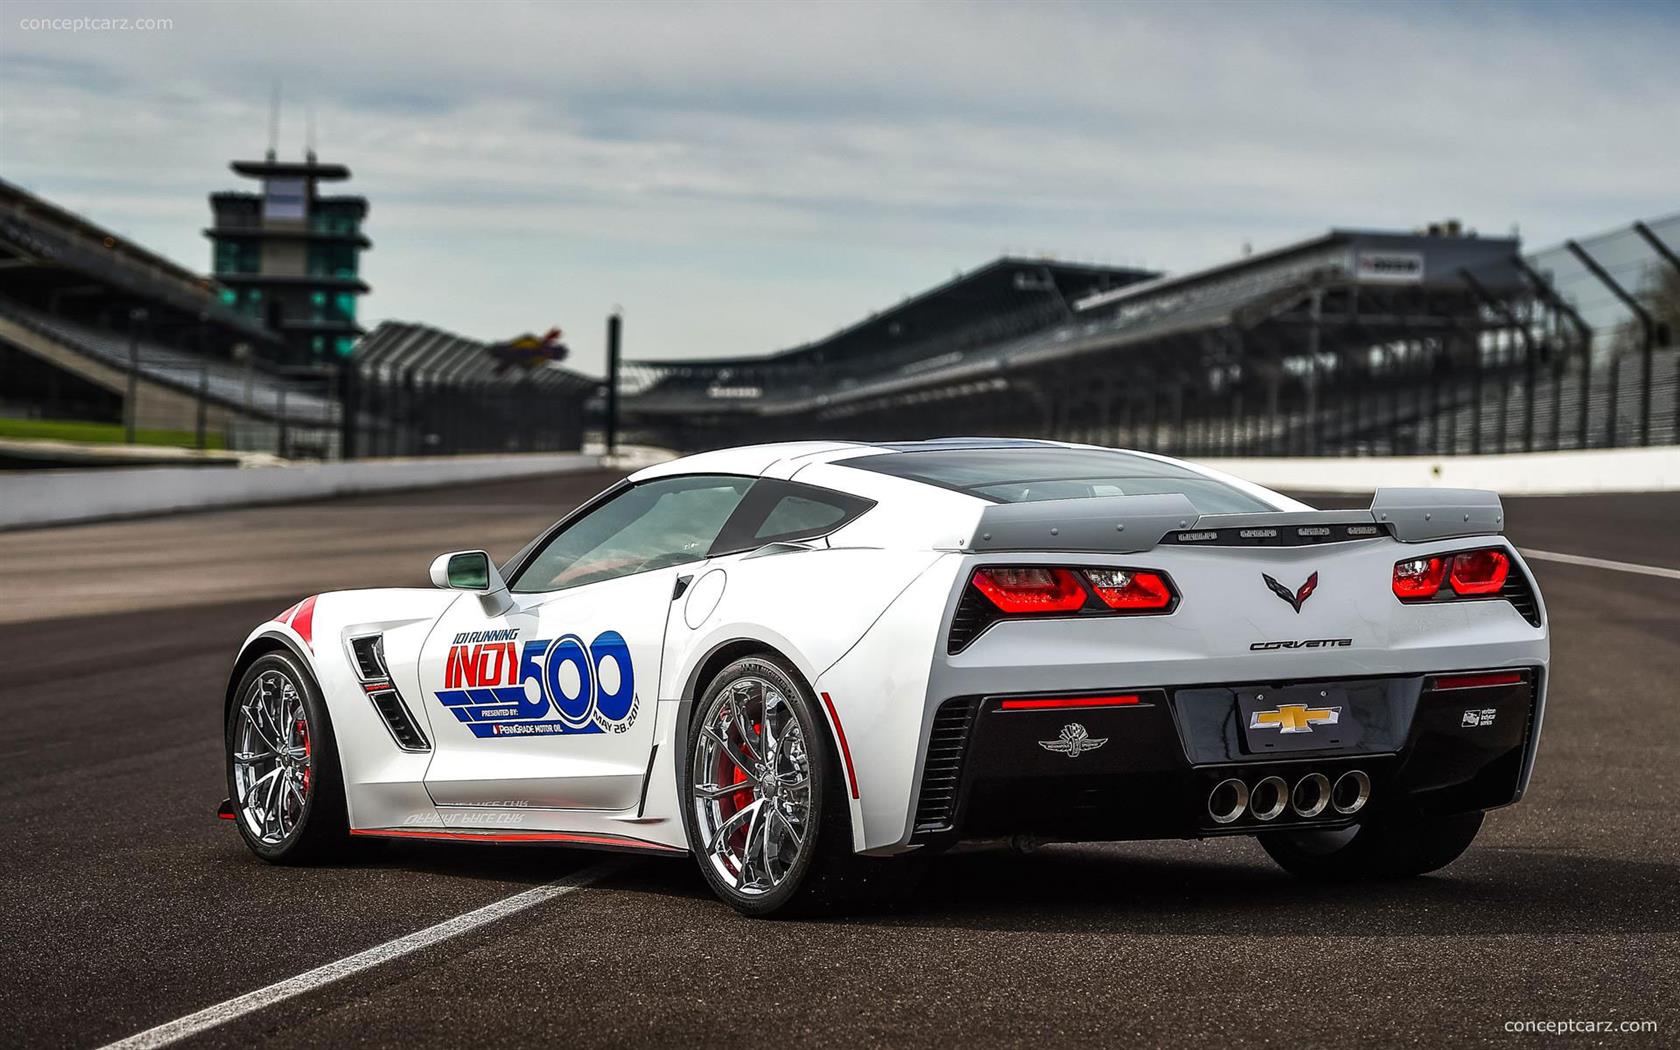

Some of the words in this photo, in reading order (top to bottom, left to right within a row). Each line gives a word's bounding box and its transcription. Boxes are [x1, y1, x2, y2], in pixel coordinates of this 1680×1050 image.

[452, 632, 471, 645] 101
[468, 628, 520, 643] RUNNING
[1249, 639, 1353, 650] CORVETTE
[444, 642, 519, 689] INDY
[519, 630, 635, 725] 500
[481, 709, 509, 717] PRESENTED
[509, 708, 519, 716] BY:
[593, 709, 612, 732] MAY
[535, 724, 552, 733] MOTOR
